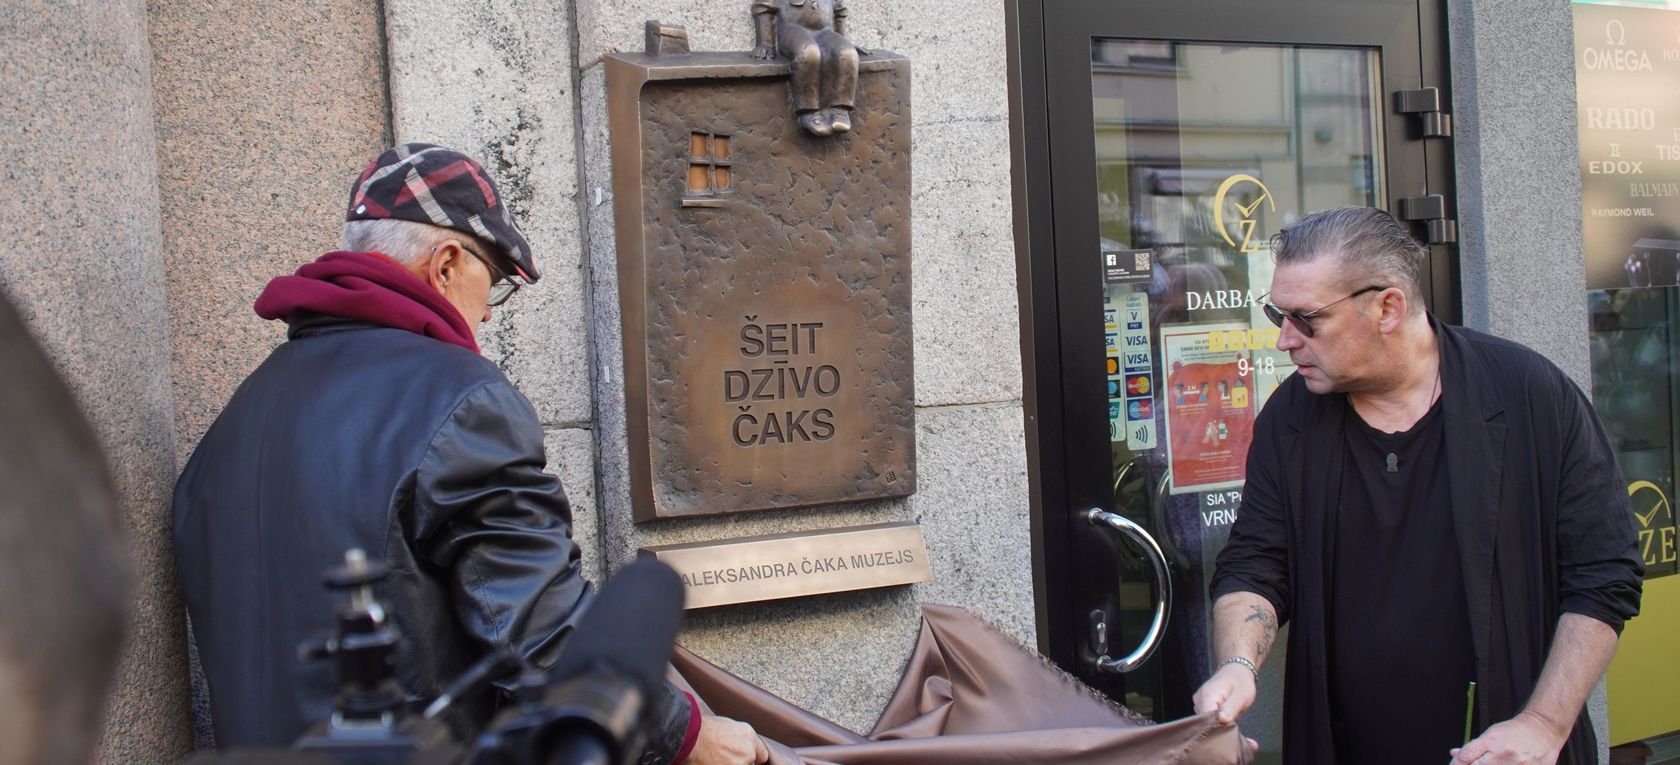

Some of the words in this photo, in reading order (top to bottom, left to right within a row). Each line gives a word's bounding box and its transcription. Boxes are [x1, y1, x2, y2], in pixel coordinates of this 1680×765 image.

[1583, 48, 1653, 72] OMEGA
[1586, 107, 1655, 130] RADO
[1589, 161, 1643, 174] EDOX
[1629, 182, 1680, 197] BALMAIN
[1591, 209, 1632, 217] RAYMOND
[1633, 208, 1654, 216] WEIL
[1186, 289, 1257, 310] DARBA
[740, 315, 823, 357] ŠEIT
[1126, 336, 1148, 346] VISA
[1127, 353, 1149, 364] VISA
[1238, 356, 1275, 376] 9-18
[724, 361, 841, 402] DZĪVO
[732, 406, 835, 447] ČAKS
[1206, 493, 1226, 506] SIA
[681, 562, 798, 587] ALEKSANDRA
[801, 556, 848, 576] ČAKA
[850, 549, 914, 572] MUZEJS
